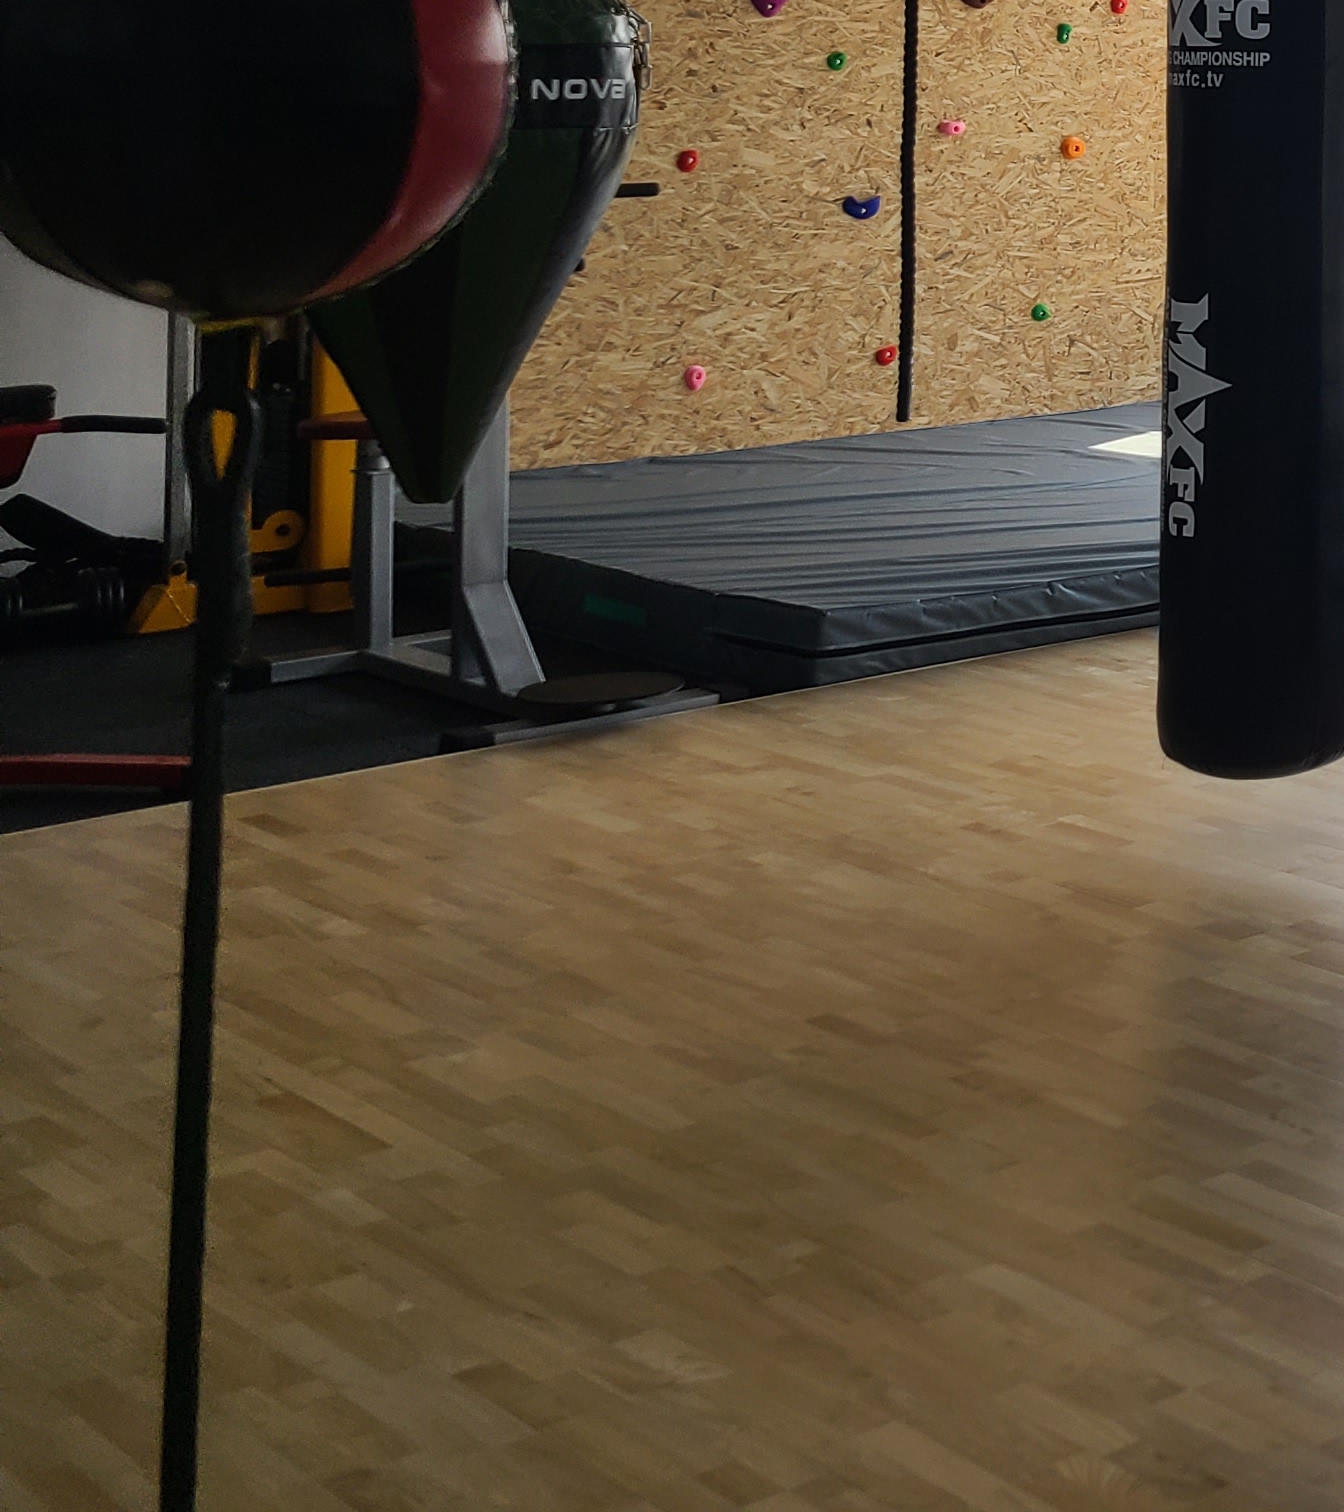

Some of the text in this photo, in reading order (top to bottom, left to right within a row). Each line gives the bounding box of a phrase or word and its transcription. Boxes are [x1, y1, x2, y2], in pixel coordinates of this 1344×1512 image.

[1172, 50, 1271, 67] CHAMPIONSHIP
[1168, 68, 1224, 88] axfc.tv
[1166, 292, 1234, 538] MAXFC
